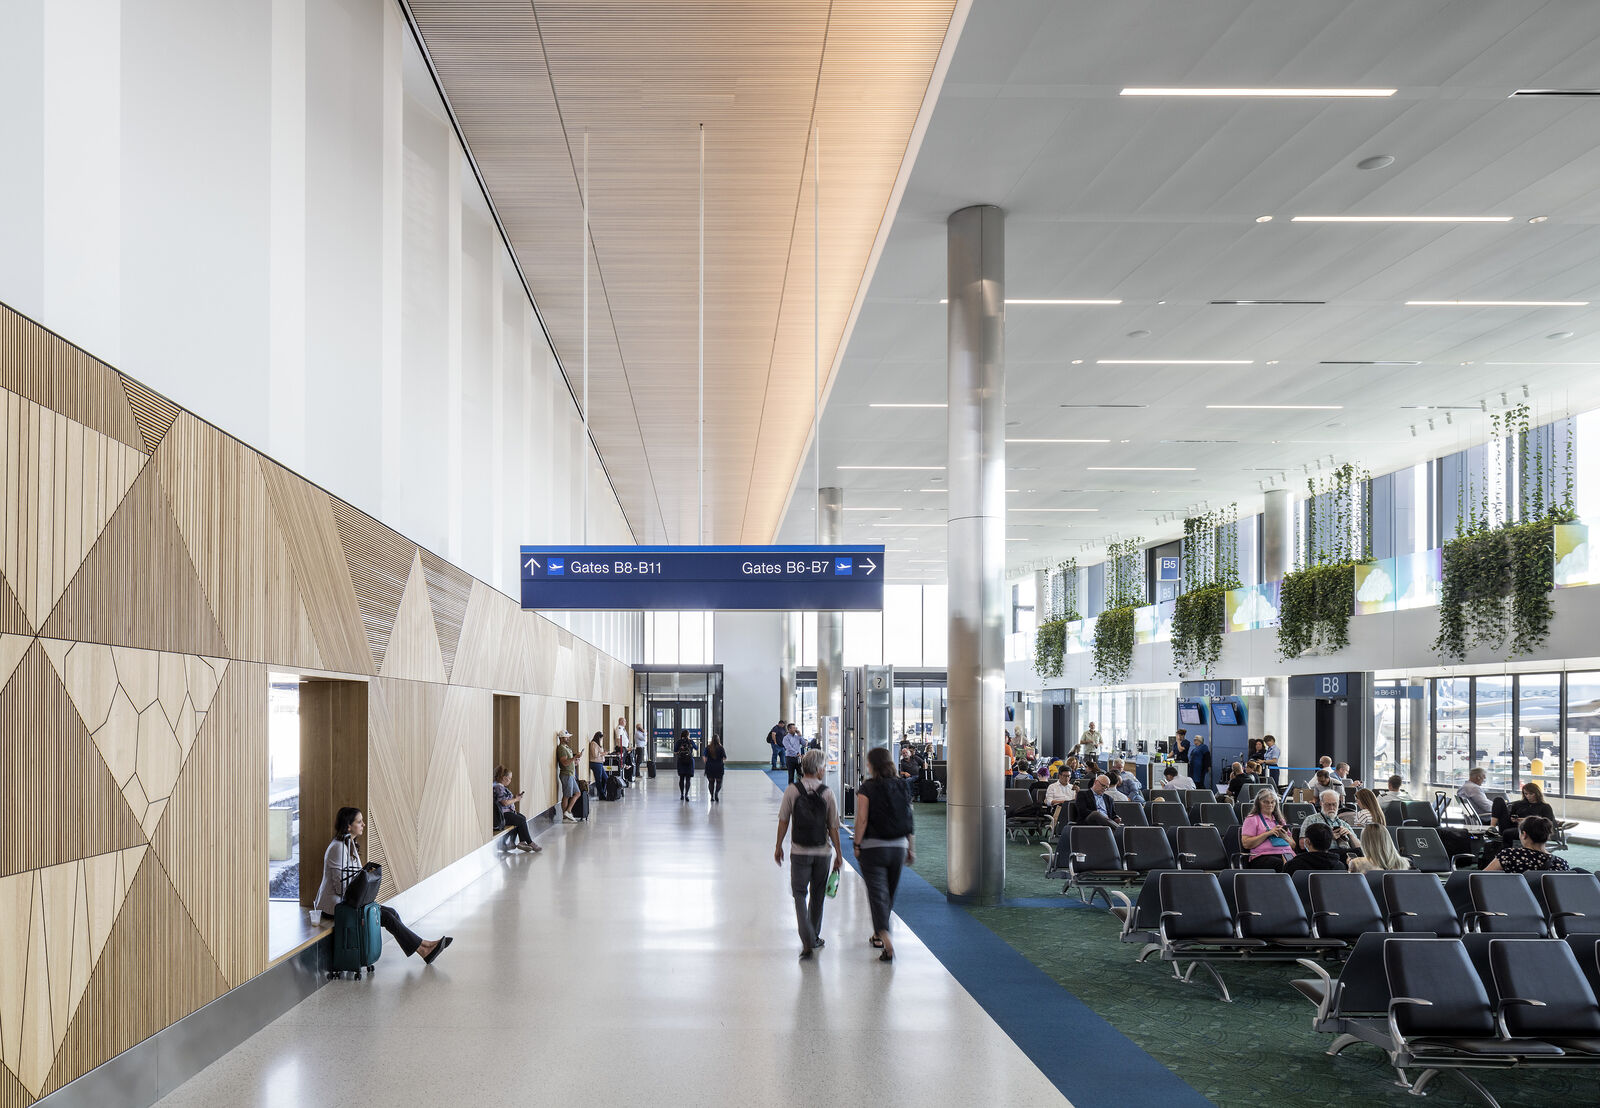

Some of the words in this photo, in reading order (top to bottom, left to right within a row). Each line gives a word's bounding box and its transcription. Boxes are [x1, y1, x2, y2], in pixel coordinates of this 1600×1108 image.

[570, 560, 610, 574] Gates
[614, 560, 661, 574] B8-B11
[741, 560, 782, 575] Gates
[786, 560, 830, 574] B6-B7
[1163, 560, 1177, 569] B5
[1203, 683, 1216, 697] B9
[1322, 677, 1340, 694] B8
